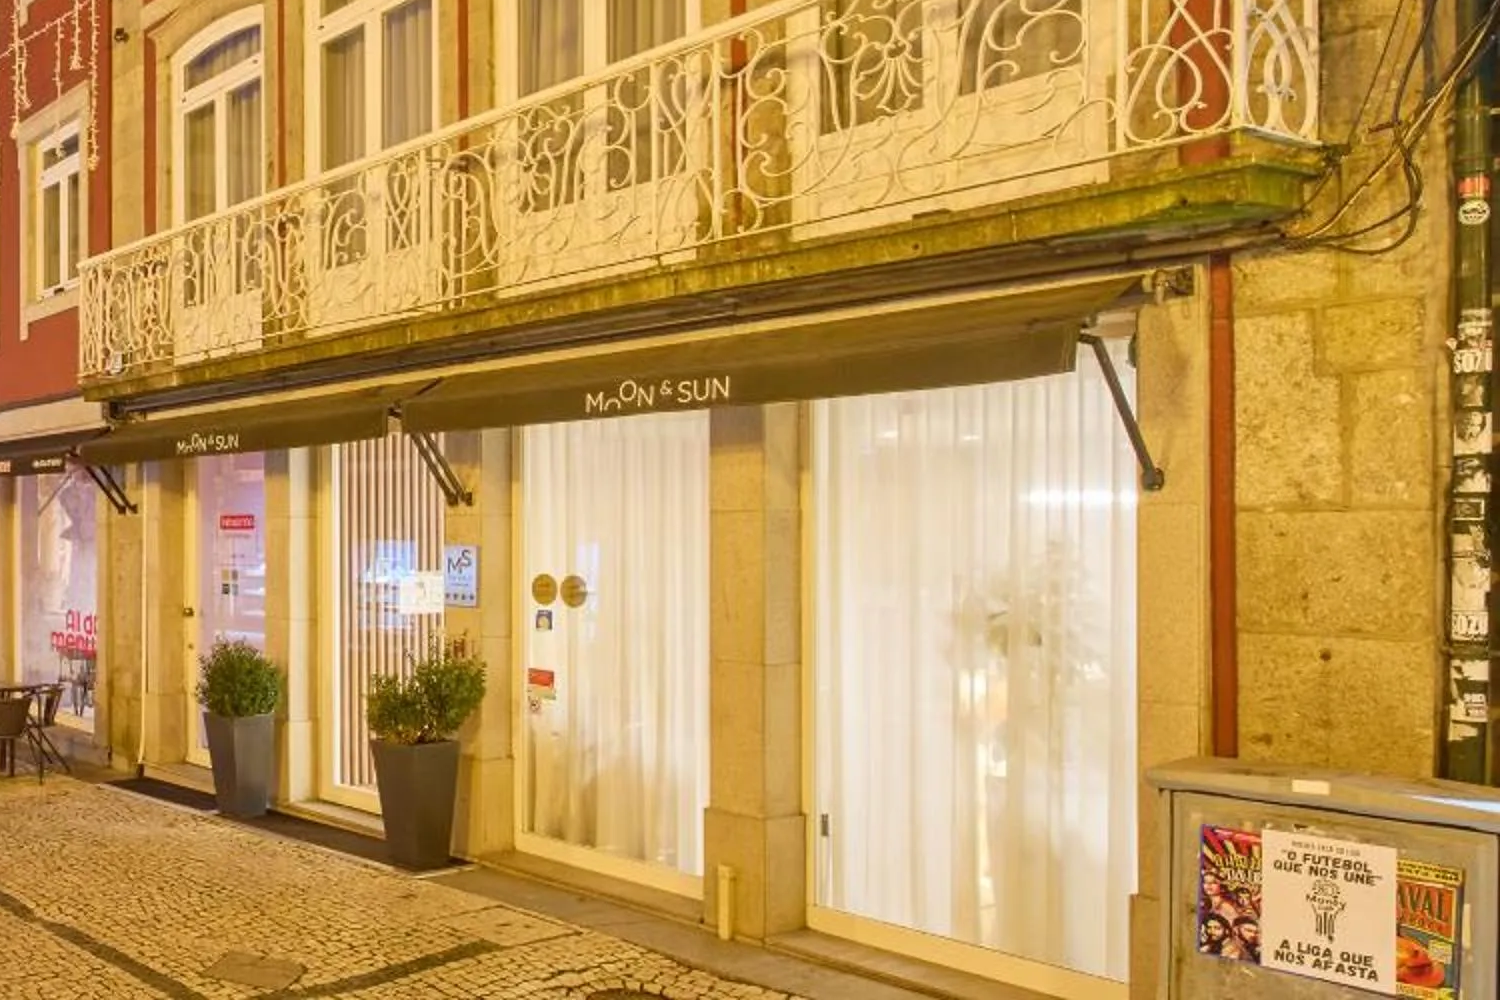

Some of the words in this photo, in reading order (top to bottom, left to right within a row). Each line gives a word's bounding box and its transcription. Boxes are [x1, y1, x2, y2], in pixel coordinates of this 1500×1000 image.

[660, 379, 673, 396] &
[677, 376, 731, 402] SUN
[1273, 860, 1303, 874] QUE
[1309, 865, 1338, 880] NOS
[1344, 871, 1376, 886] UNE
[1303, 853, 1372, 874] FUTEBOL
[1274, 950, 1305, 966] NOS
[1312, 958, 1379, 982] AFASTA
[1280, 939, 1290, 950] A
[1297, 941, 1333, 958] LIGA
[1340, 951, 1373, 967] QUE
